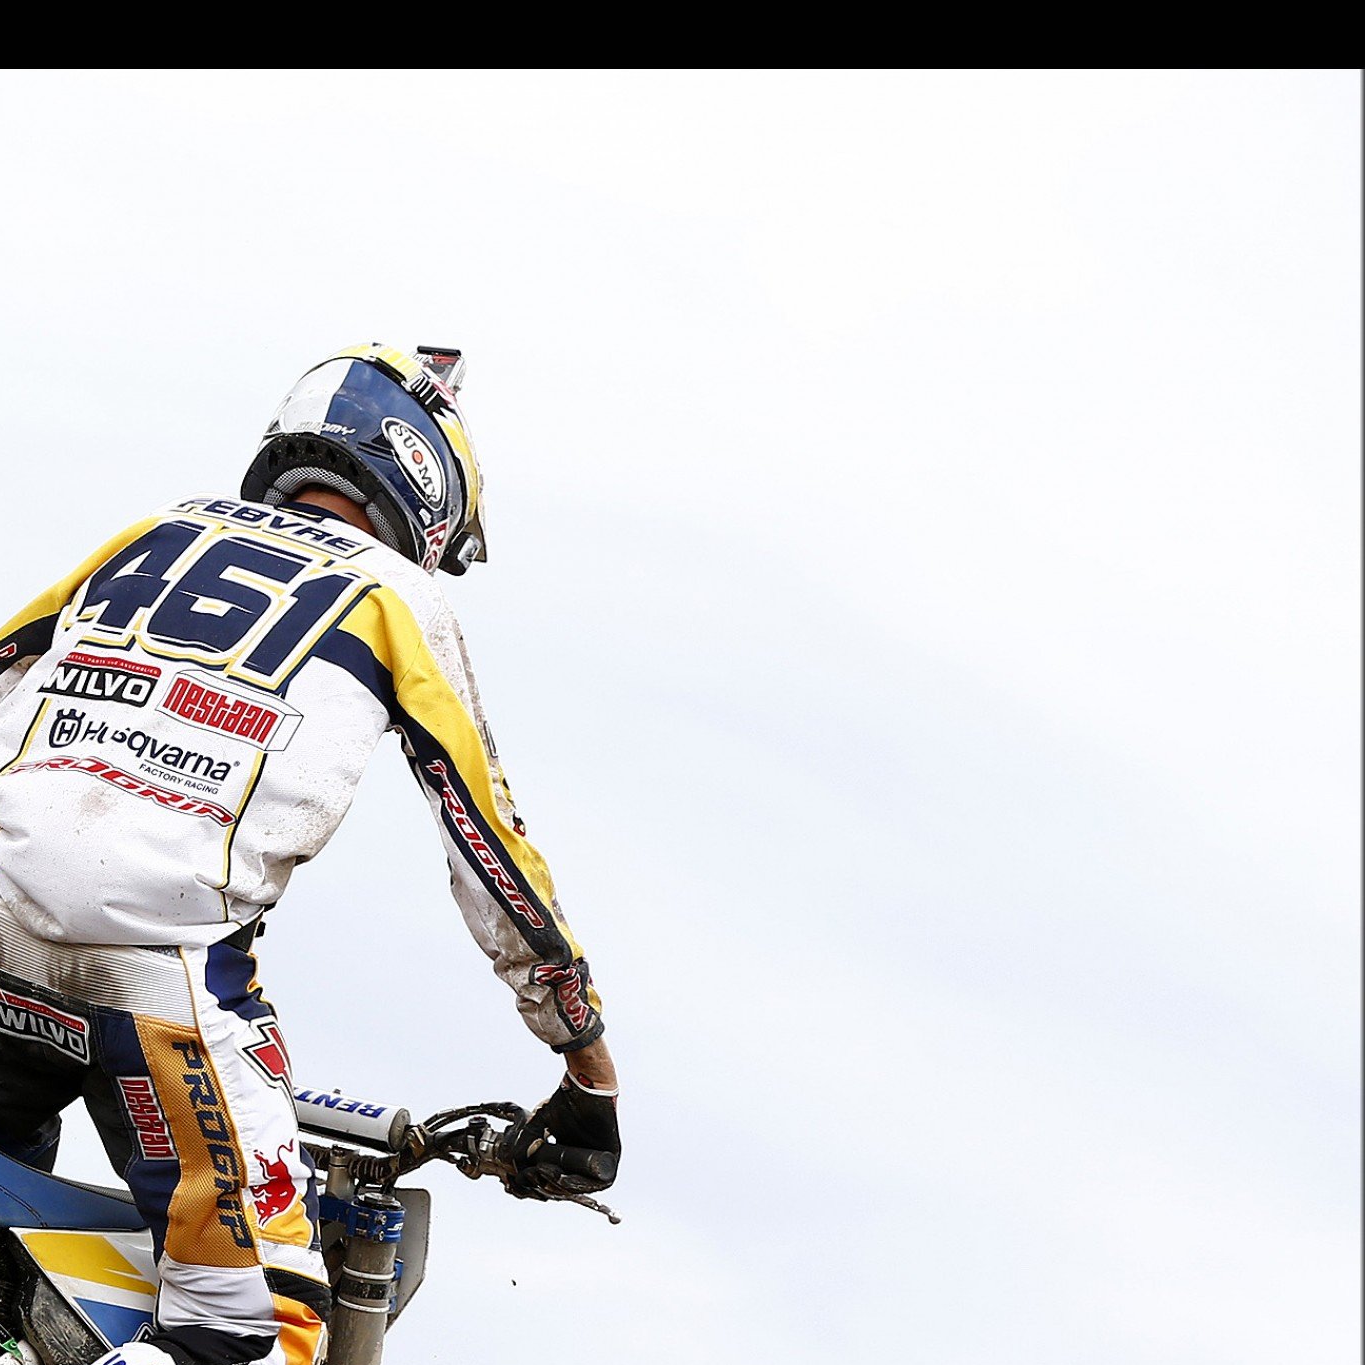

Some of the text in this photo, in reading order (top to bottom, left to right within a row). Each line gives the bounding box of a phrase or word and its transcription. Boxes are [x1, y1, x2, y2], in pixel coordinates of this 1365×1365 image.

[394, 424, 439, 502] SUOMY
[173, 497, 361, 553] FEBVRE
[72, 516, 364, 682] 461
[138, 762, 220, 796] FACTORY RACING
[294, 1087, 387, 1119] RENT
